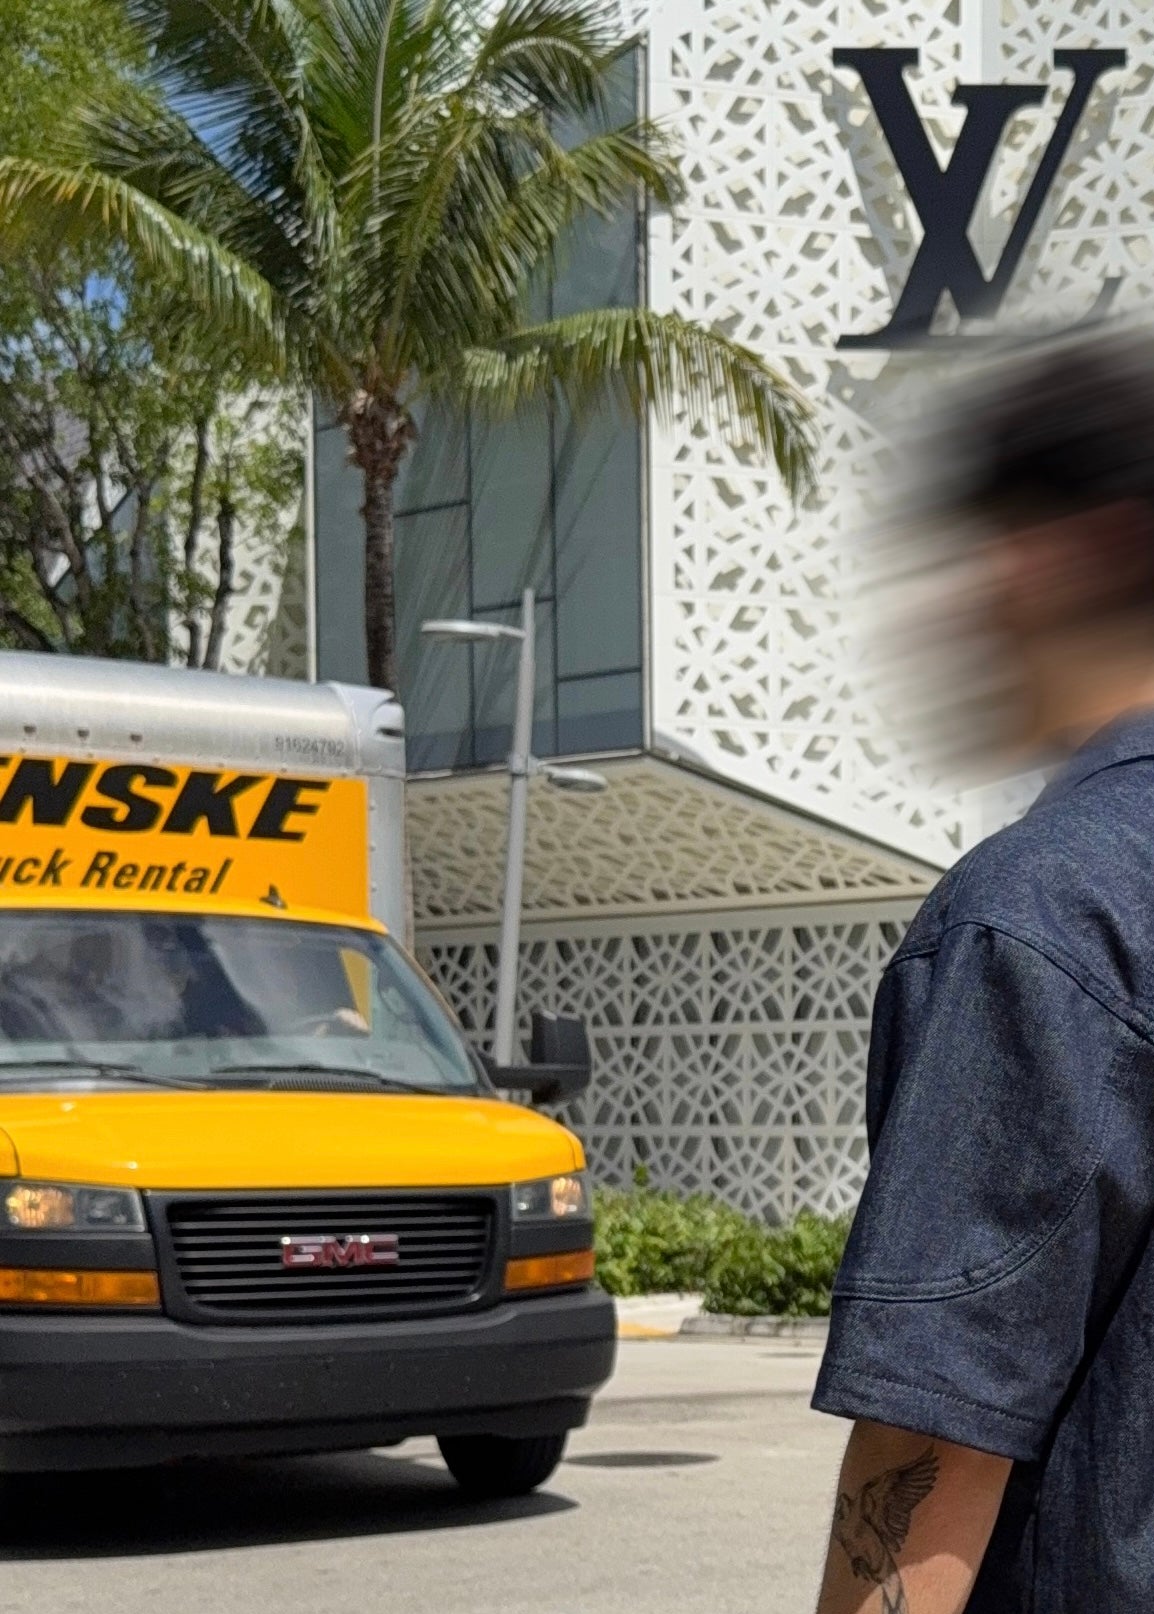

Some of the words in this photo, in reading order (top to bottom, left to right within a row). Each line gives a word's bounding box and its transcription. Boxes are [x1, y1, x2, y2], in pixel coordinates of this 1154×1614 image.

[0, 756, 332, 842] NSKE
[80, 850, 234, 895] Rental
[281, 1235, 399, 1267] GMC
